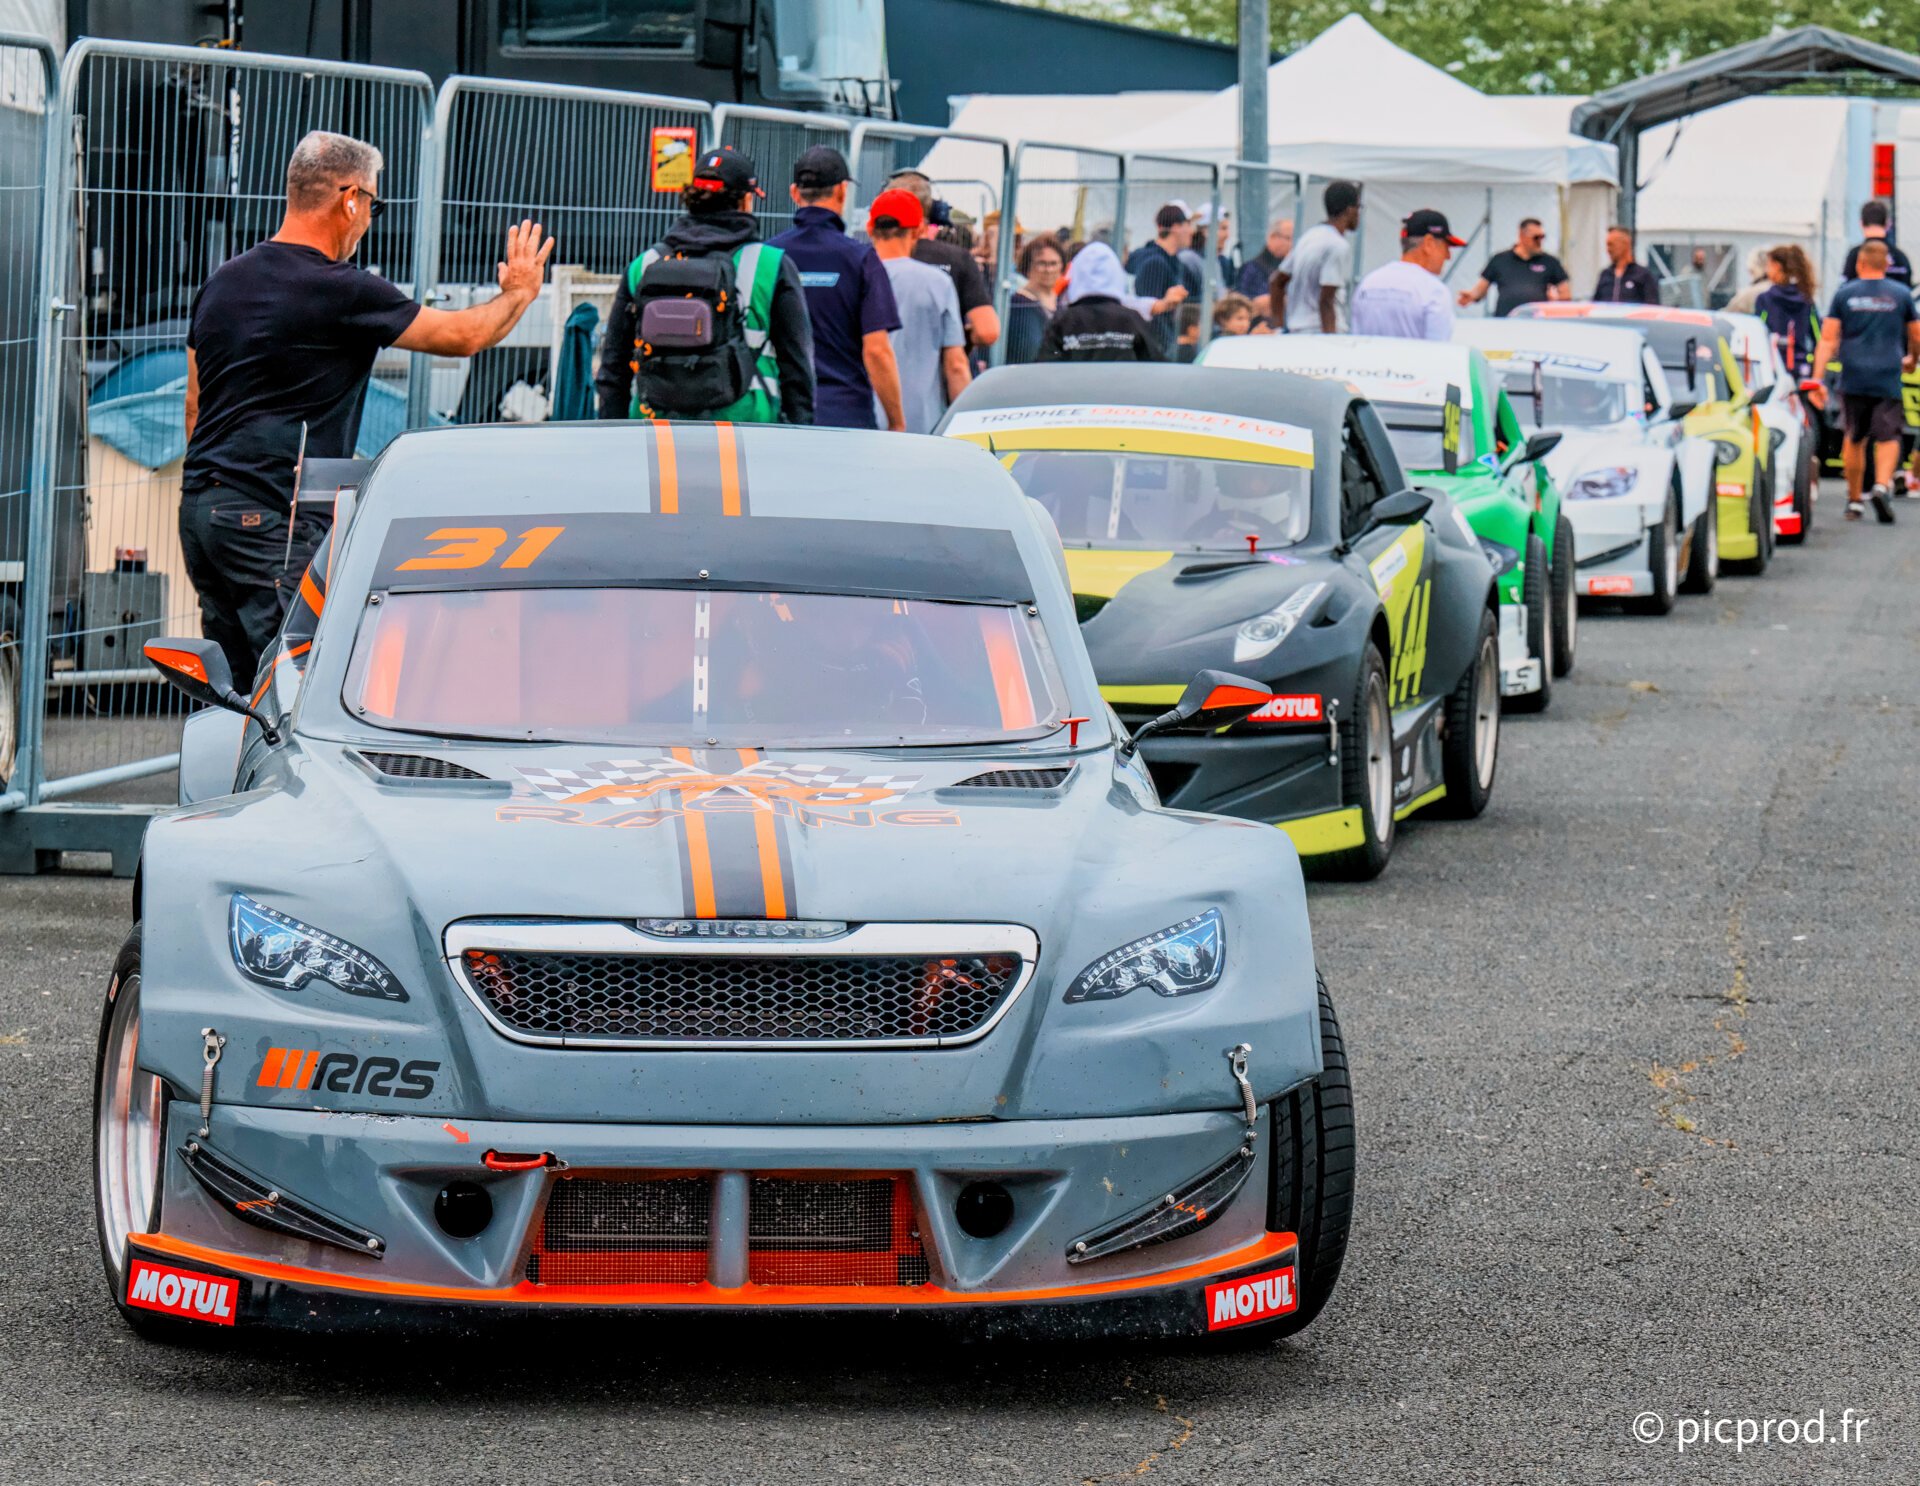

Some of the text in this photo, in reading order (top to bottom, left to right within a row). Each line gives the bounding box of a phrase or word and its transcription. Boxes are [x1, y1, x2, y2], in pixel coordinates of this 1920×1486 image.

[394, 526, 566, 571] 31
[495, 795, 962, 829] RACING
[311, 1053, 442, 1100] RRS
[131, 1268, 231, 1317] MOTUL
[1213, 1274, 1293, 1323] MOTUL
